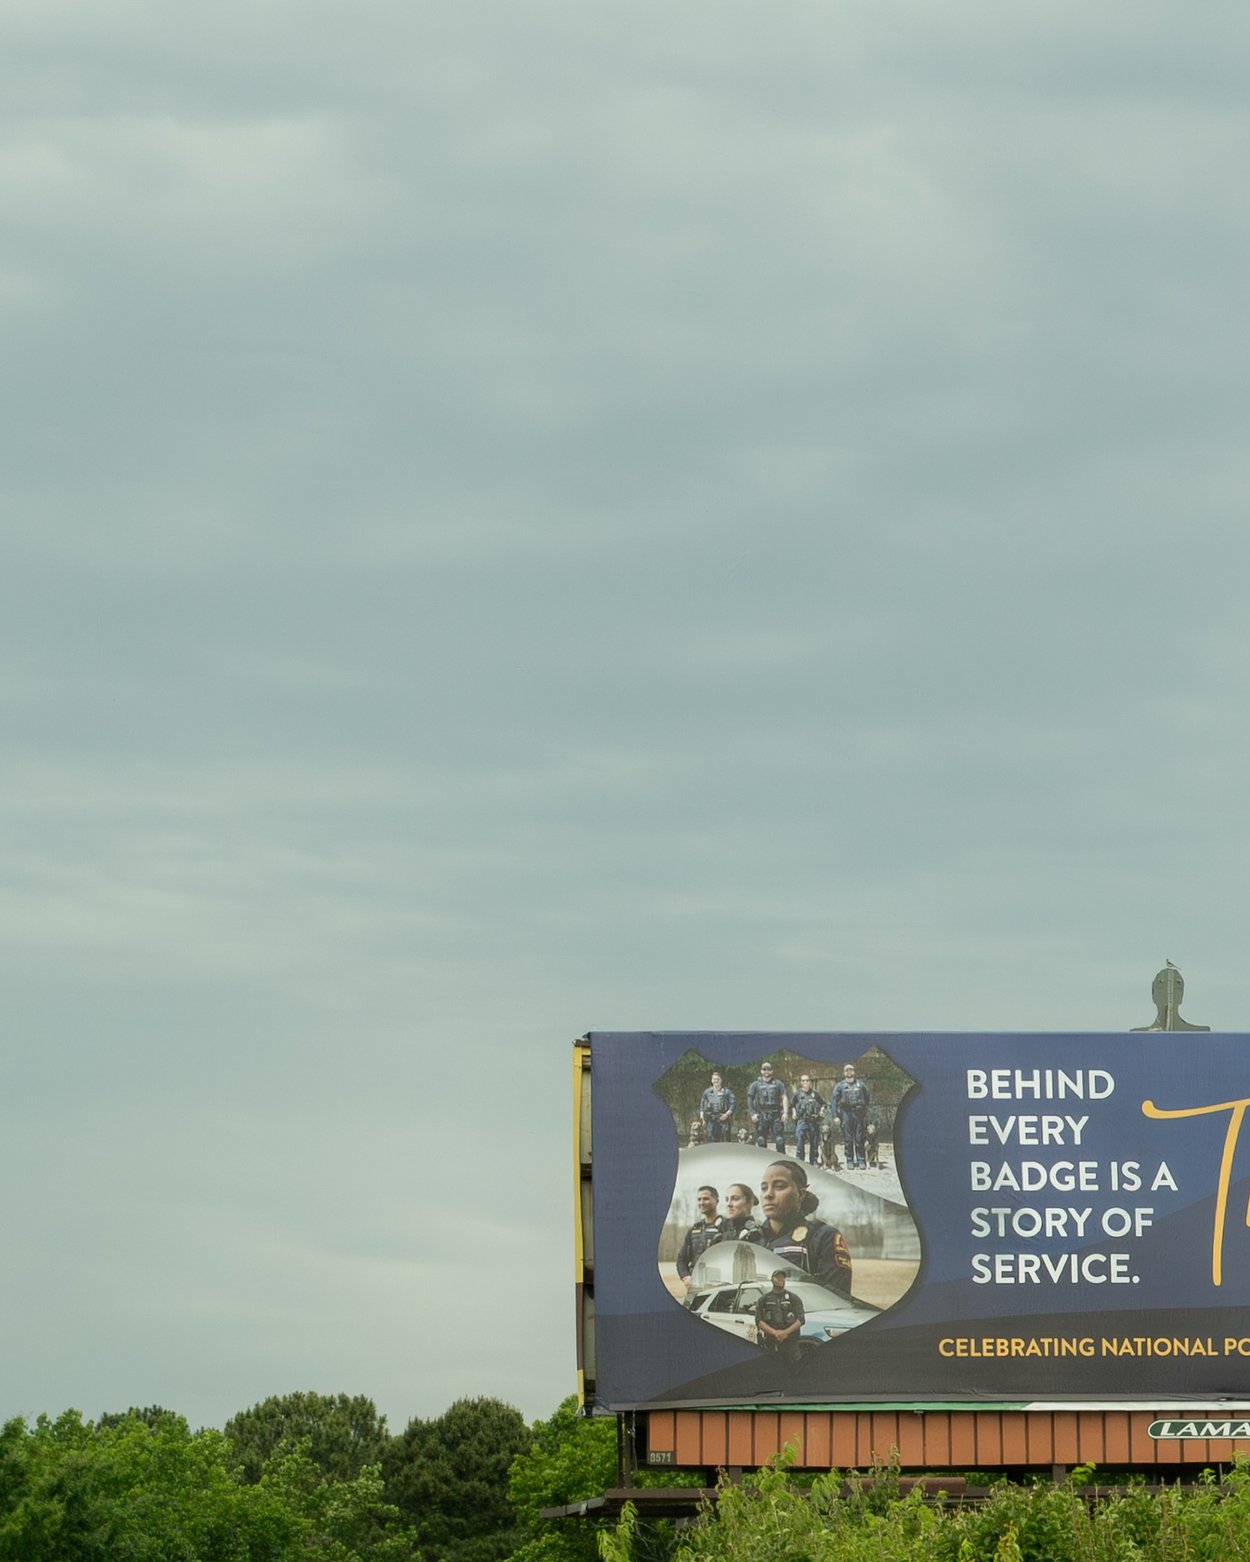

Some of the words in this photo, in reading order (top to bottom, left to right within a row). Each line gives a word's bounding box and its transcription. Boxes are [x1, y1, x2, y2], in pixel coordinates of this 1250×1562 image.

[966, 1068, 1115, 1100] BEHIND
[968, 1115, 1090, 1146] EVERY
[970, 1160, 1099, 1192] BADGE
[1110, 1160, 1142, 1192] IS
[1150, 1161, 1179, 1192] A
[970, 1207, 1093, 1238] STORY
[1101, 1207, 1154, 1238] OF
[971, 1253, 1140, 1284] SERVICE.
[938, 1336, 1096, 1358] CELEBRATING
[1100, 1336, 1219, 1358] NATIONAL
